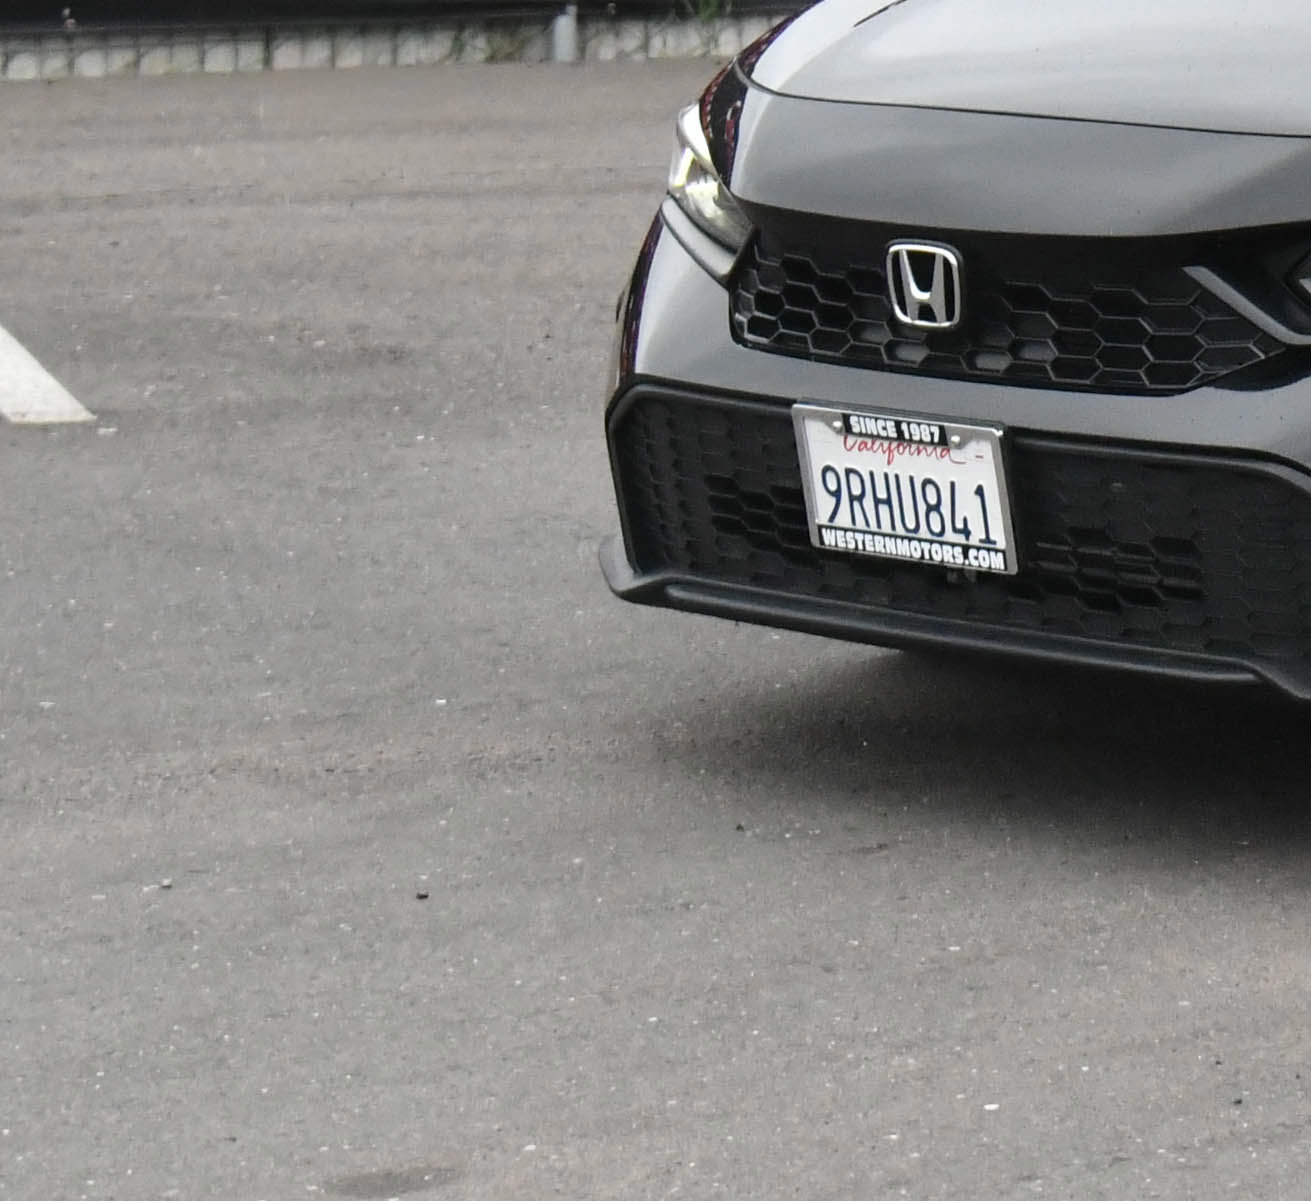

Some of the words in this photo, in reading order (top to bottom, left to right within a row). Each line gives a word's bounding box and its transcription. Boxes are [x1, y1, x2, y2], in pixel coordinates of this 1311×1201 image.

[849, 415, 898, 438] SINCE
[900, 421, 940, 443] 1987
[821, 464, 998, 546] 9RHU841
[821, 527, 1006, 570] WESTERNMOTORS.COM
